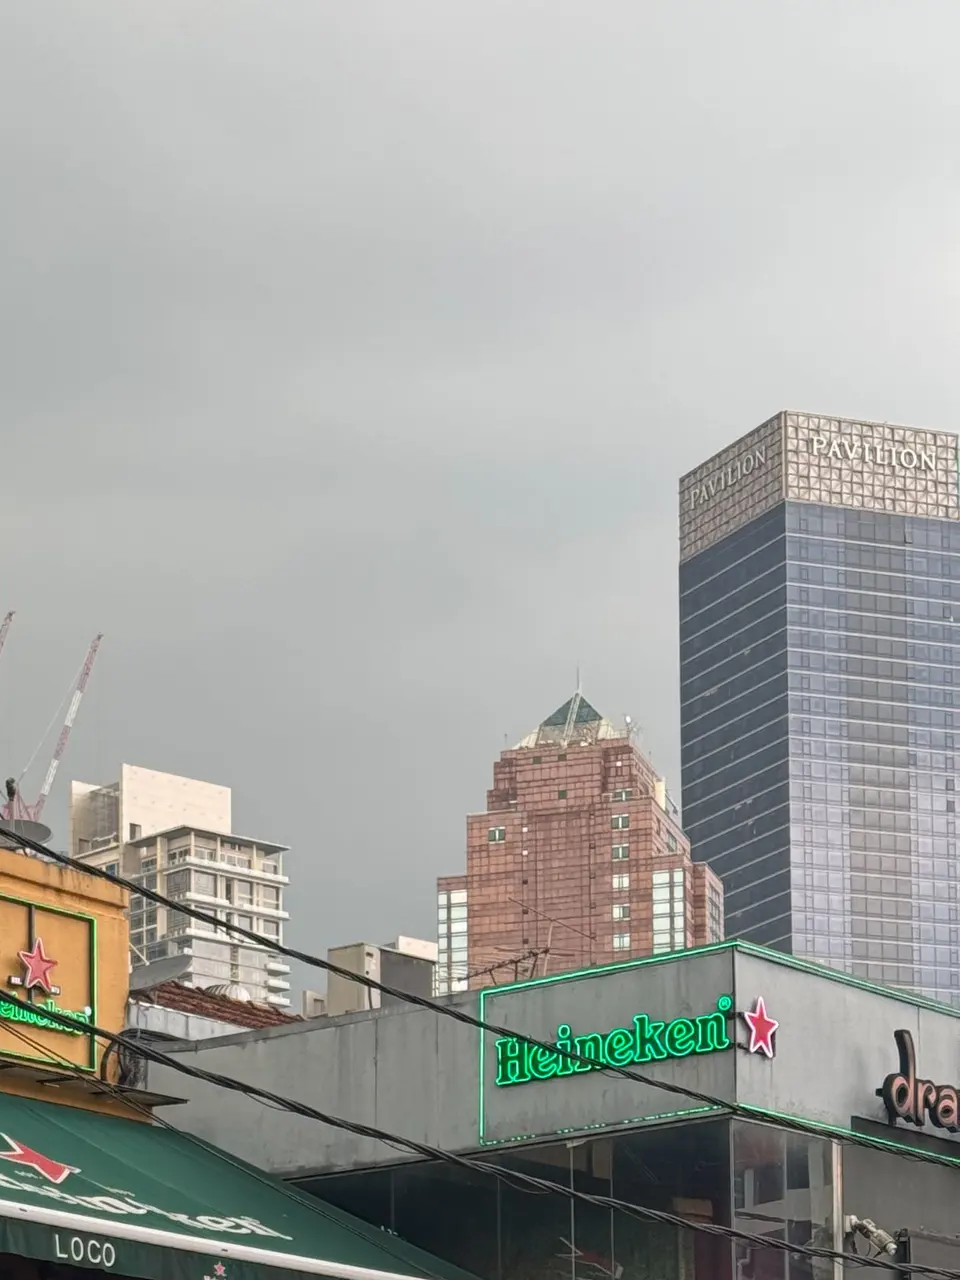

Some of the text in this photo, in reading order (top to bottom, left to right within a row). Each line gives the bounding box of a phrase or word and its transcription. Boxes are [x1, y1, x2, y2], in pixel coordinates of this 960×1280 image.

[690, 446, 768, 509] PAVILION
[810, 436, 937, 471] PAVILION
[495, 1012, 731, 1086] Heineken
[55, 1234, 116, 1267] LOCO
